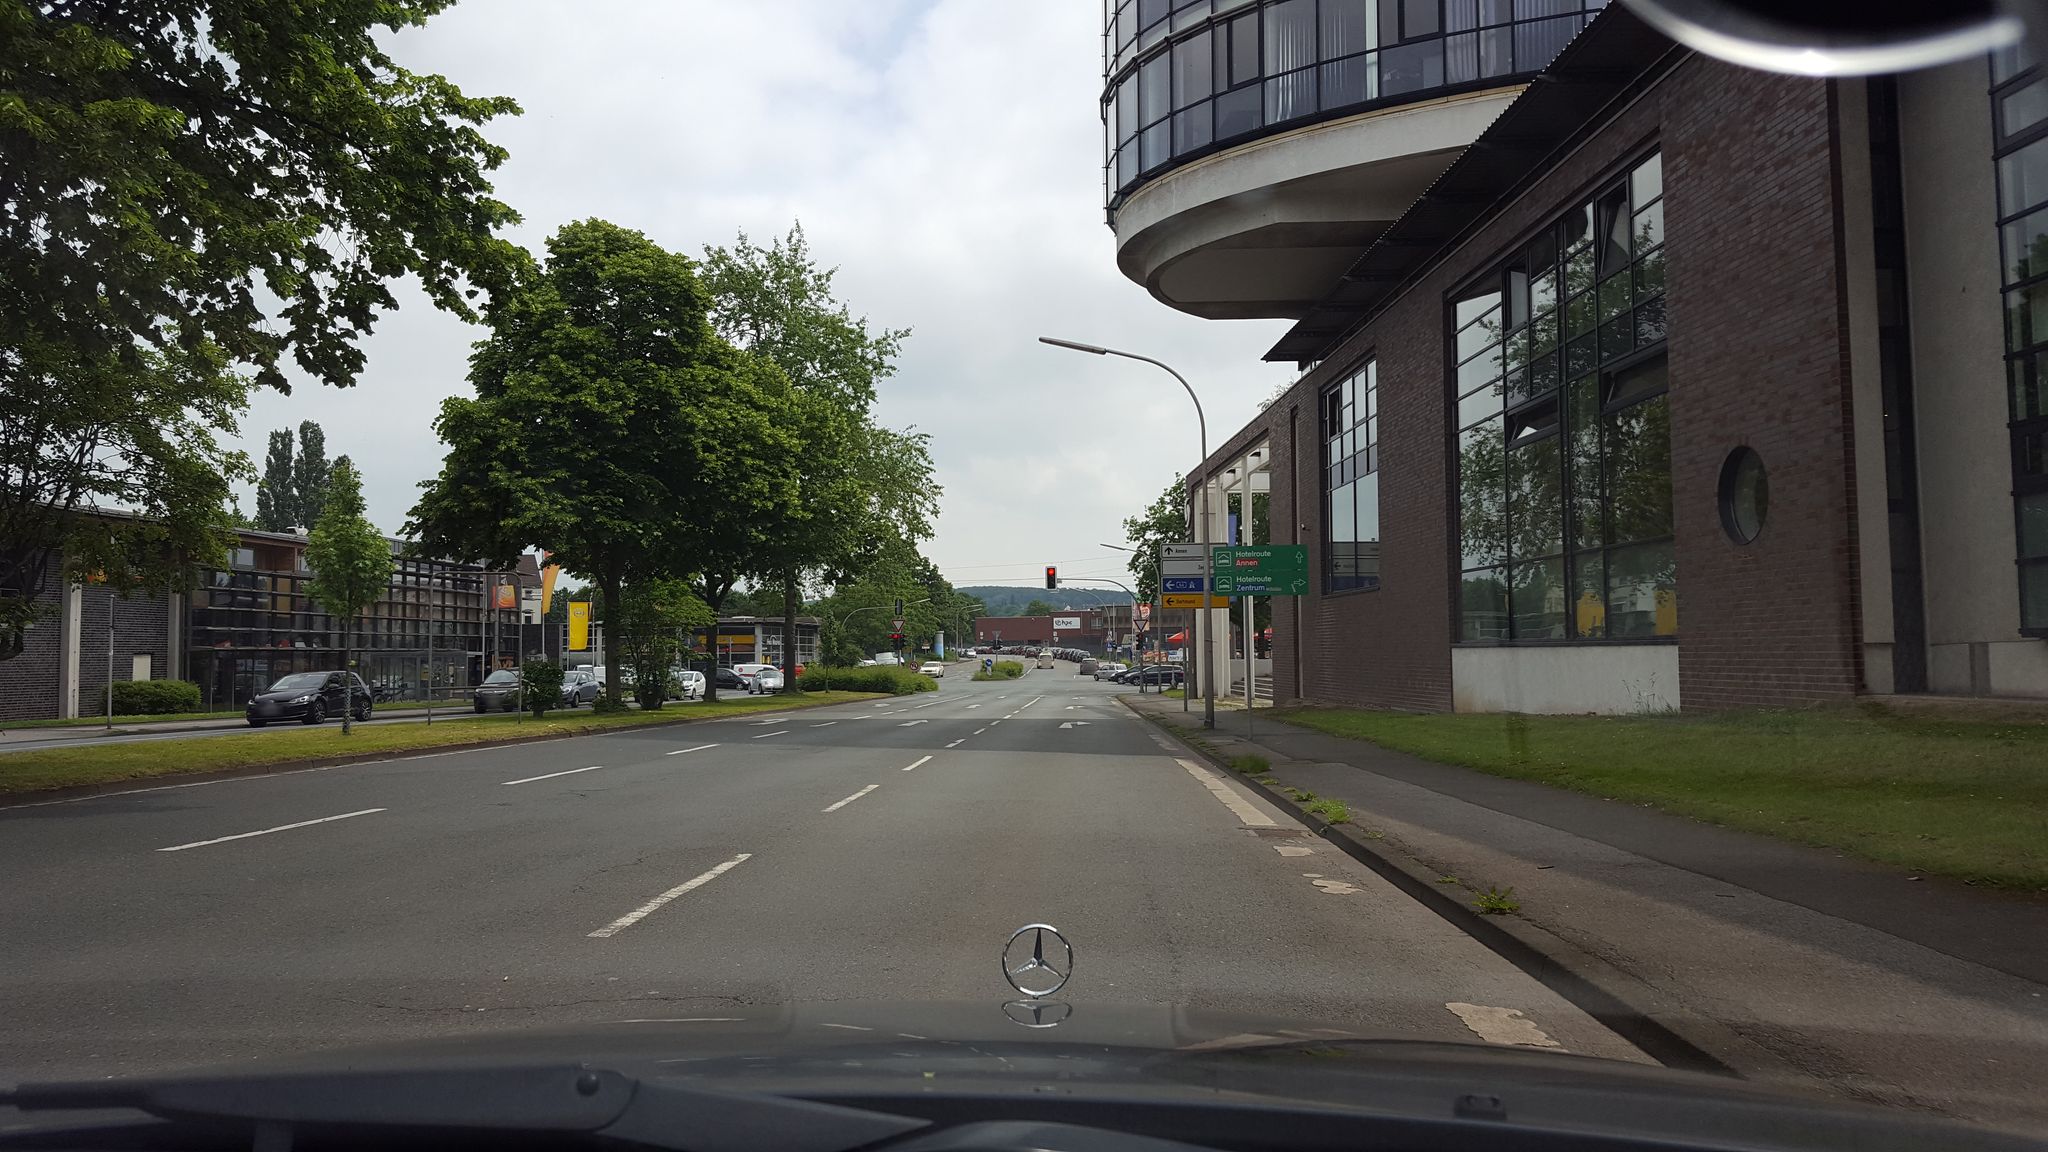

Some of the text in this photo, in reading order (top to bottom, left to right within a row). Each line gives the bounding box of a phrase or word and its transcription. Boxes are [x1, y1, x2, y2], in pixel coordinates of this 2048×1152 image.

[1235, 550, 1271, 558] Hotelroute
[1236, 575, 1272, 583] Hotelroute
[1236, 584, 1265, 592] Zentrum
